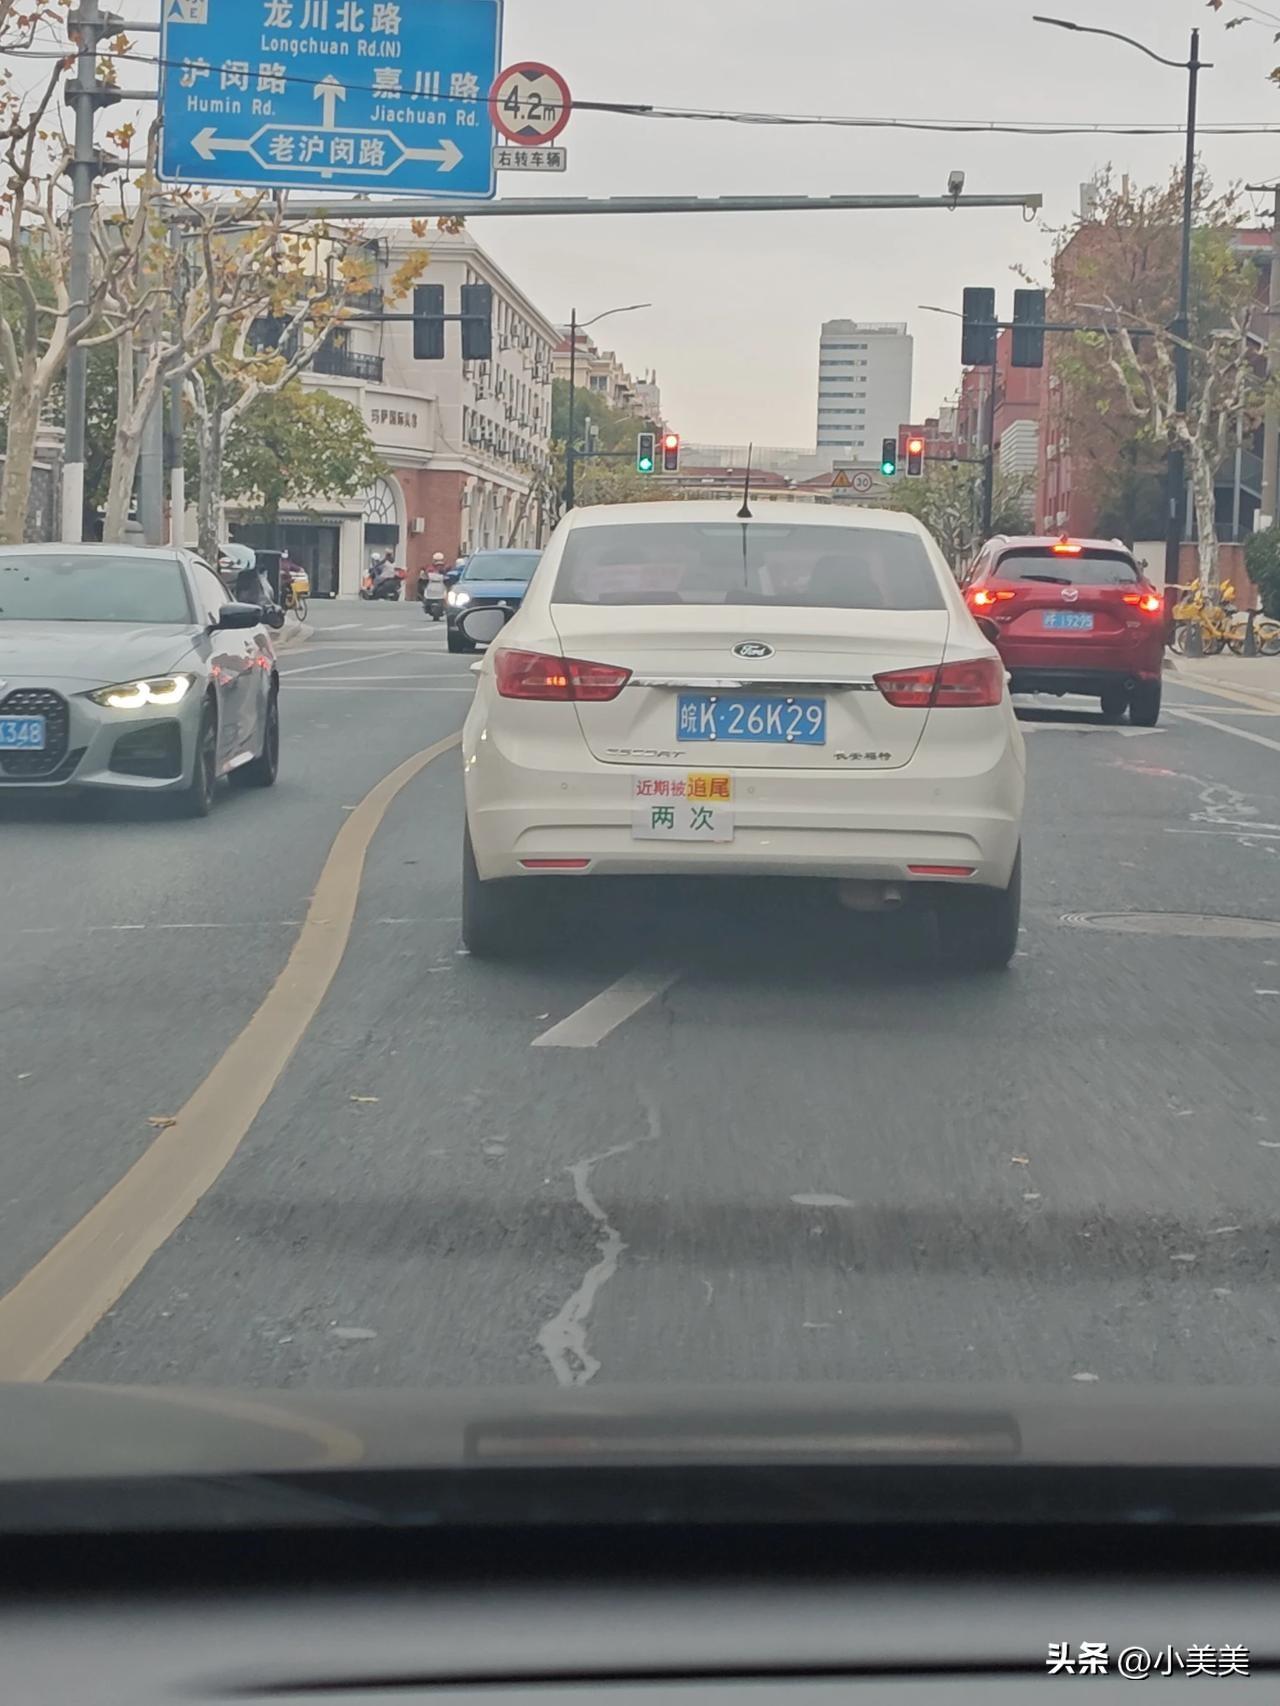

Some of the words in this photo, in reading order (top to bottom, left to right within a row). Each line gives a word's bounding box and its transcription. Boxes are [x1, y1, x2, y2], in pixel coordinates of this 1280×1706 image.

[263, 0, 402, 34] 龙川北路
[261, 34, 349, 57] Longchuan
[357, 39, 401, 58] Rd.(N)
[180, 57, 287, 94] 沪闵路
[372, 67, 480, 103] 嘉川路
[187, 95, 241, 113] Humin
[252, 98, 276, 116] Rd.
[503, 85, 556, 120] 4.2m
[370, 105, 446, 125] Jiachuan
[456, 109, 480, 127] Rd.
[268, 134, 385, 167] 老沪闵路
[498, 151, 561, 167] 右转车辆
[740, 644, 767, 656] Ford
[680, 702, 823, 735] 皖K·26K29
[636, 777, 730, 798] 近期被追尾
[651, 805, 715, 831] 两次
